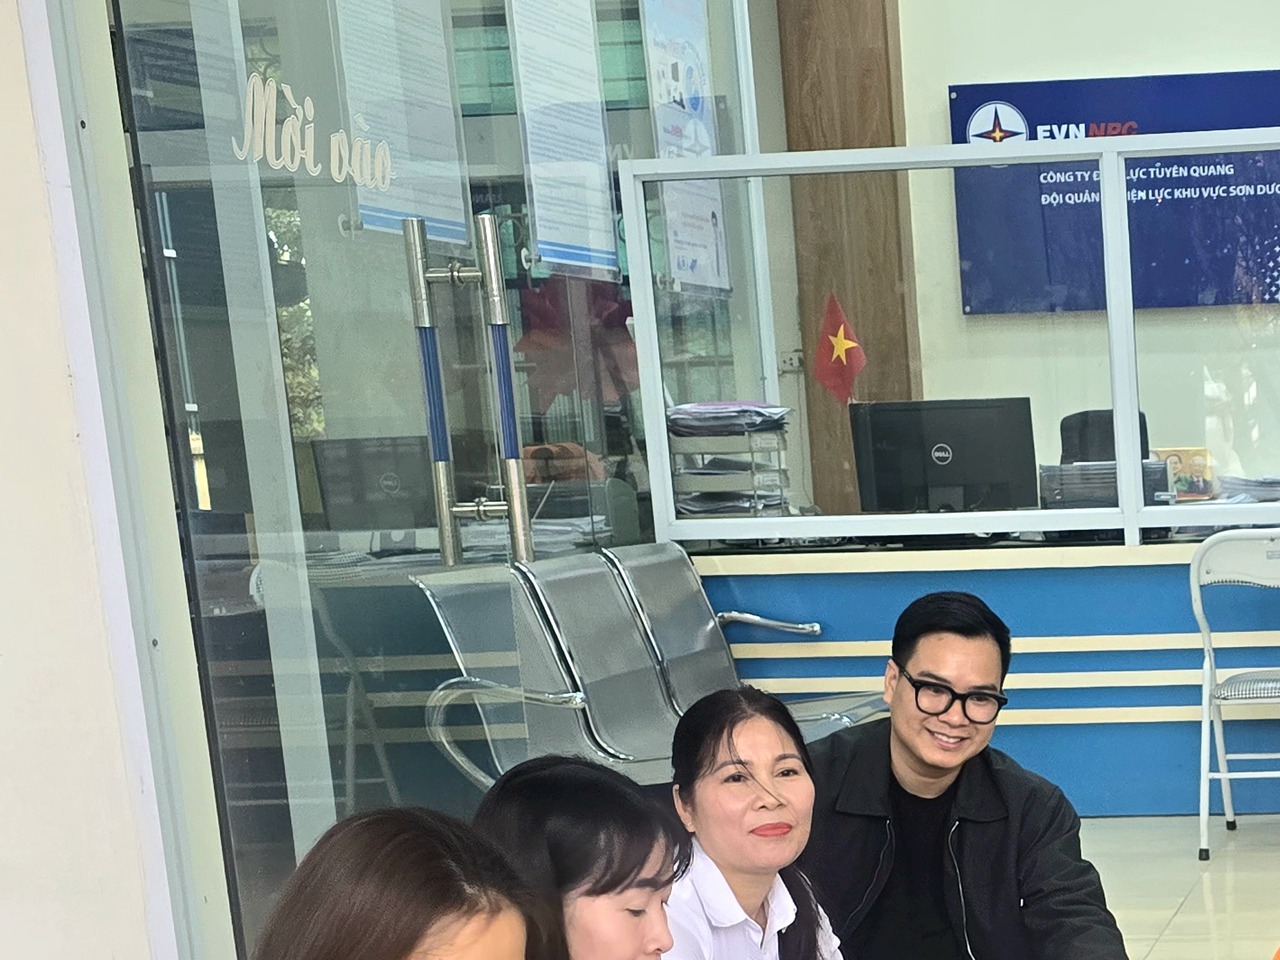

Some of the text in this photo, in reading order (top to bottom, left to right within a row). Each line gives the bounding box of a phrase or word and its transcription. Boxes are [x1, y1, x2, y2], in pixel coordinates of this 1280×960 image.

[232, 72, 322, 176] Mời
[330, 113, 397, 192] vào
[1040, 170, 1074, 183] CÔNG
[1075, 170, 1091, 182] TY
[1126, 167, 1147, 182] ỰC
[1148, 165, 1188, 179] TUYÊN
[1190, 164, 1234, 178] QUANG
[1041, 191, 1064, 206] ĐỘI
[1065, 189, 1100, 205] QUẢN
[1126, 188, 1147, 203] IỆN
[1148, 187, 1172, 203] LỰC
[1174, 187, 1200, 199] KHU
[1201, 185, 1228, 200] VỰC
[1229, 184, 1255, 197] SƠN
